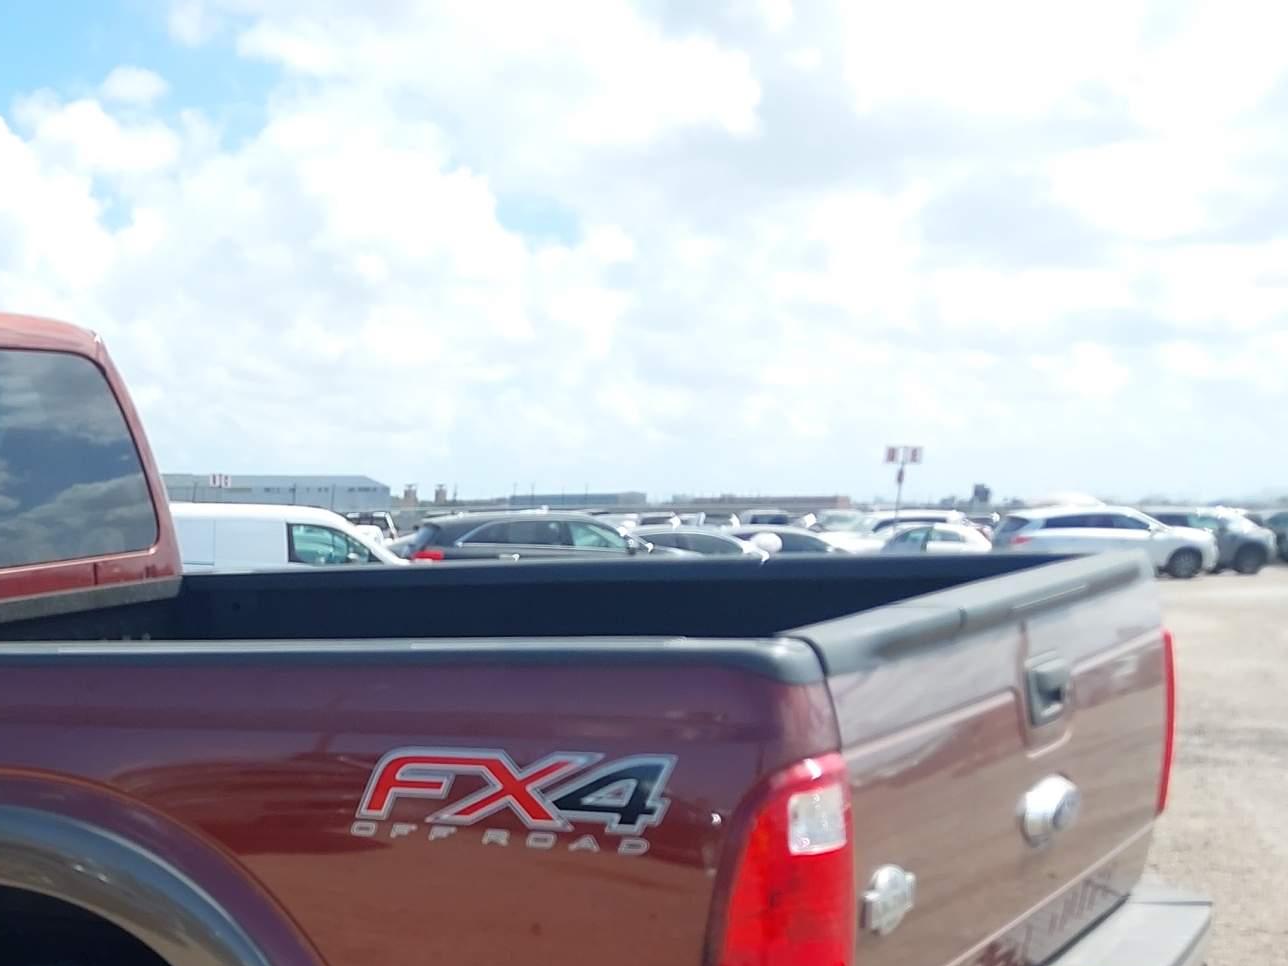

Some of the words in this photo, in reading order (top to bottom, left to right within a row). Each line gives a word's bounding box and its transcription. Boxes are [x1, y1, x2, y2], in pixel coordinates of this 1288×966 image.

[355, 745, 679, 836] FX4
[350, 821, 457, 841] OFF
[481, 828, 651, 856] ROAD
